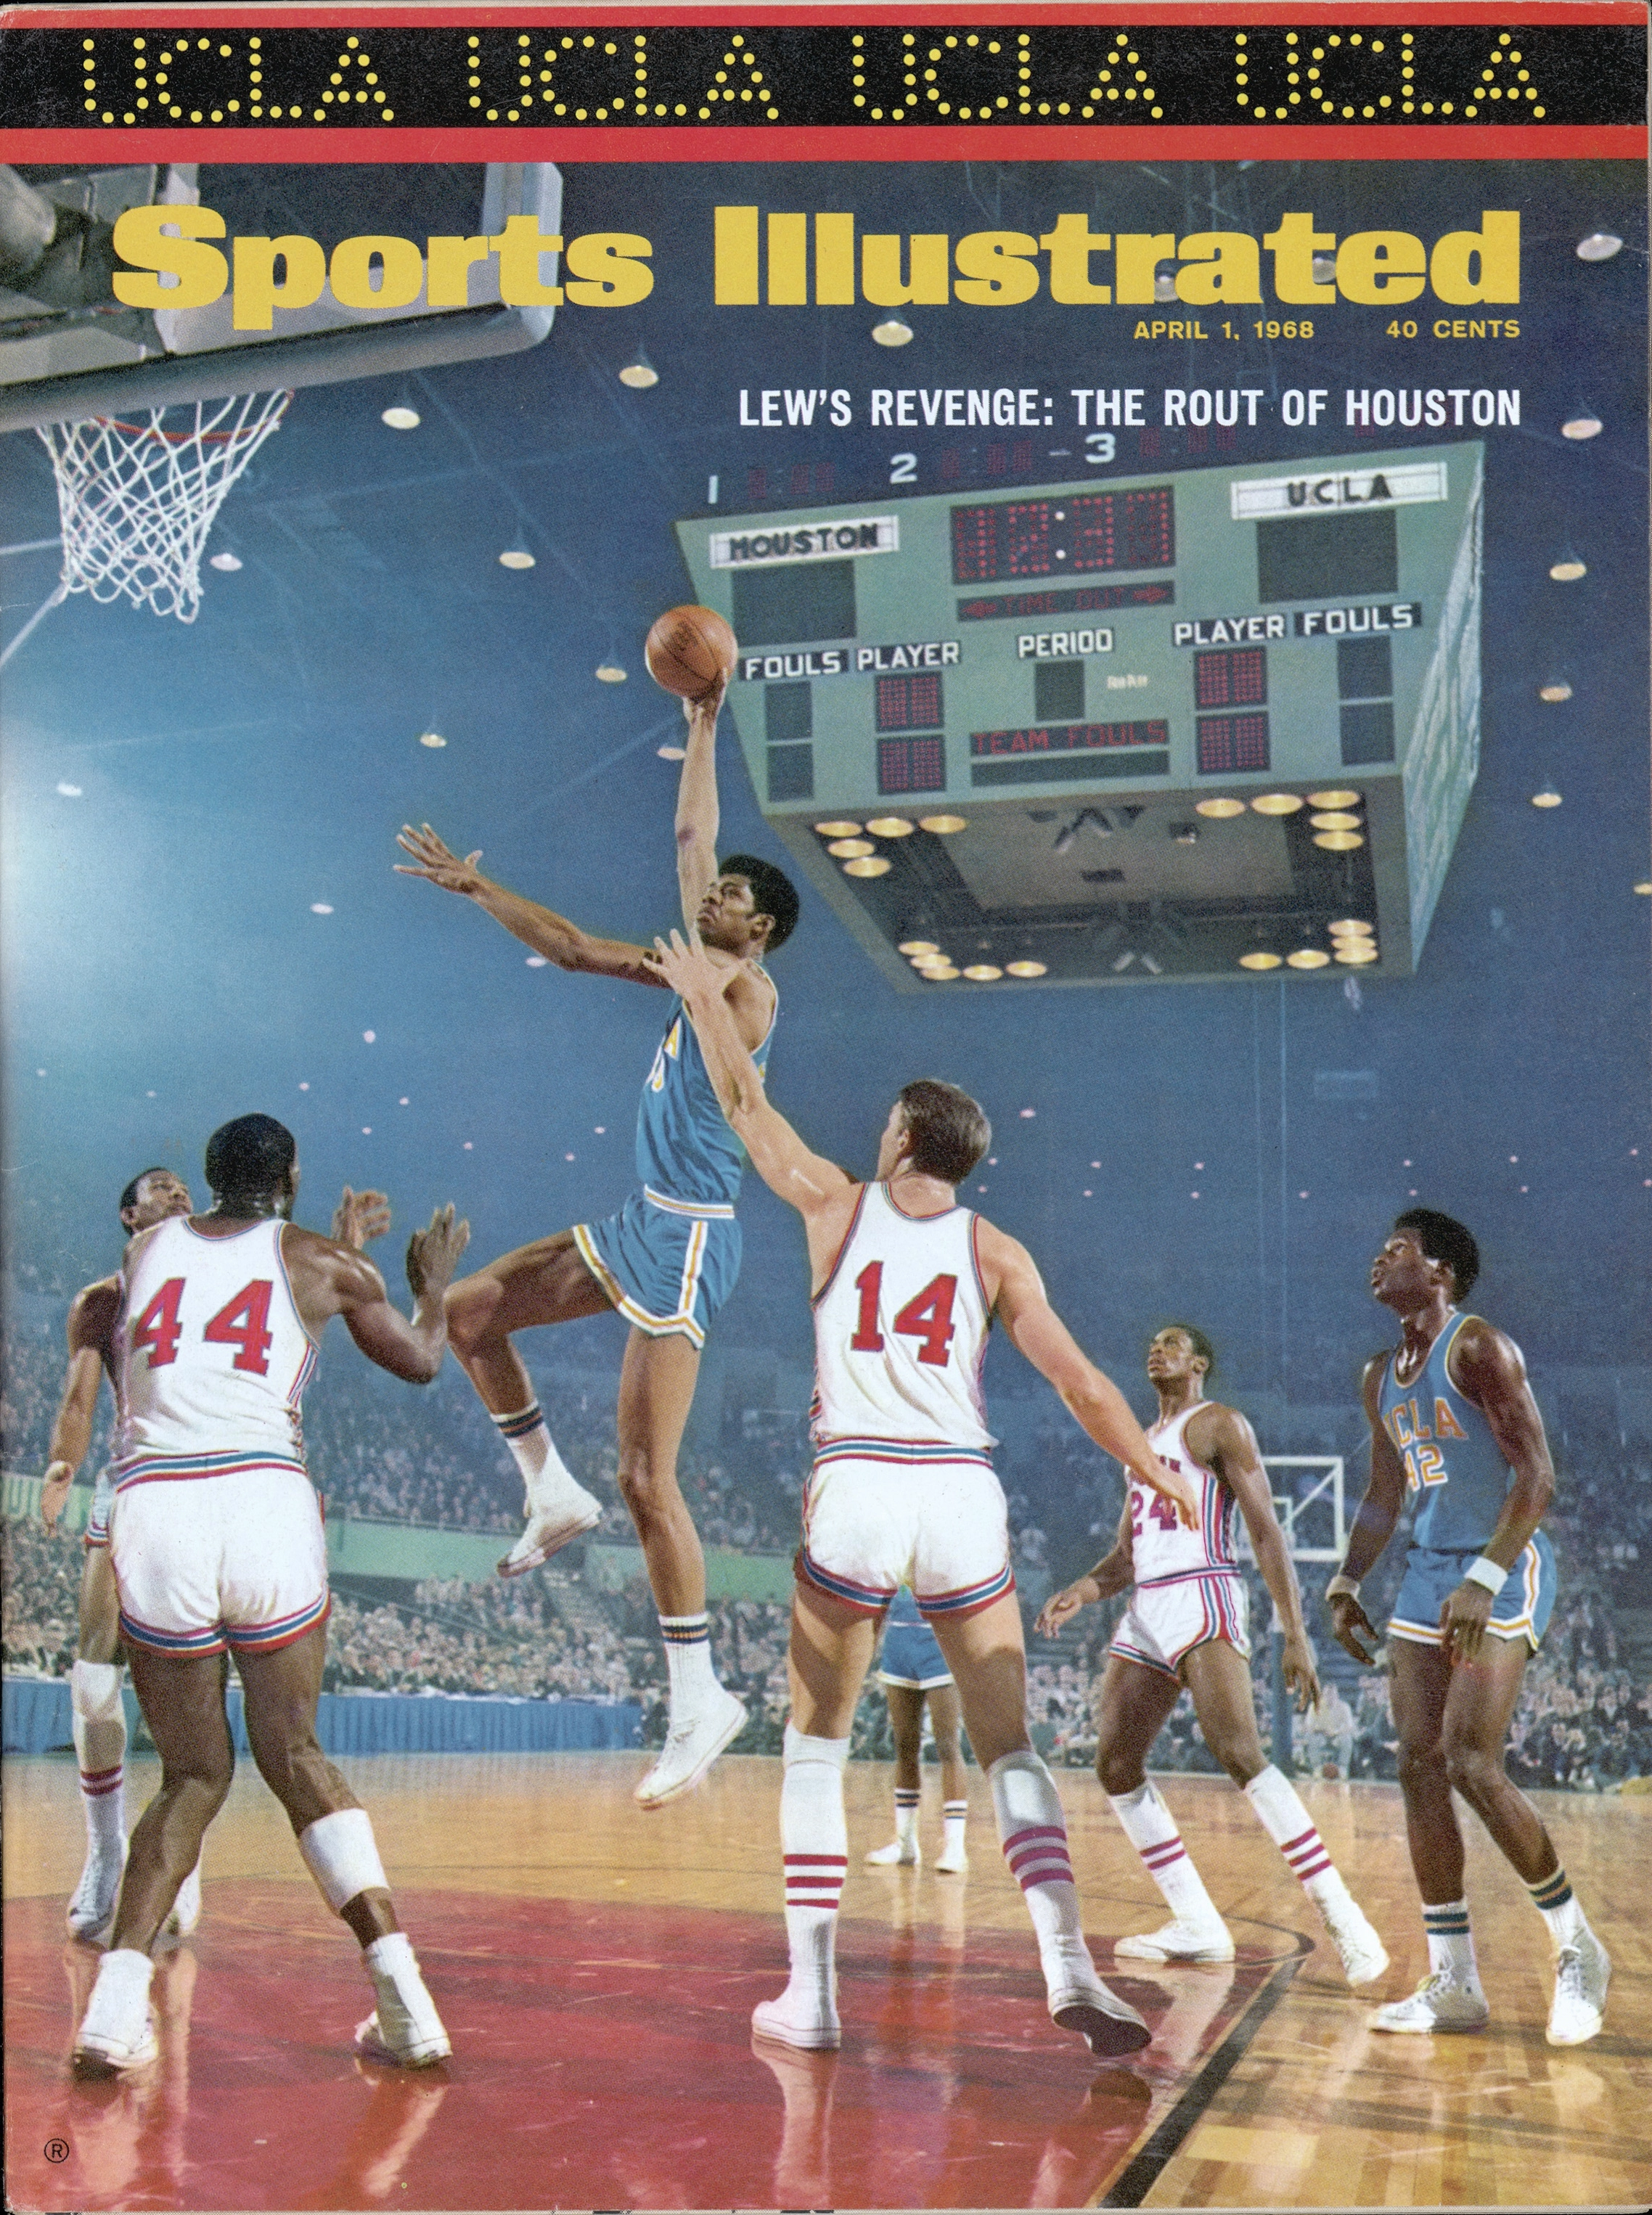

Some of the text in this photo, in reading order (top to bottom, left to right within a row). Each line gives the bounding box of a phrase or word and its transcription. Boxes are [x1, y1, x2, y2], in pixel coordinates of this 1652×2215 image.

[890, 453, 918, 484] 2
[1084, 433, 1116, 463] 3
[1287, 473, 1393, 507] UCLA
[729, 522, 878, 562] HOUSTON
[1018, 628, 1114, 658] PERIOD
[1174, 603, 1415, 646] PLAYER FOULS
[745, 642, 961, 680] FOULS PLAYER
[973, 720, 1166, 756] TEAM FOULS
[131, 1276, 274, 1377] 44
[850, 1259, 958, 1368] 14
